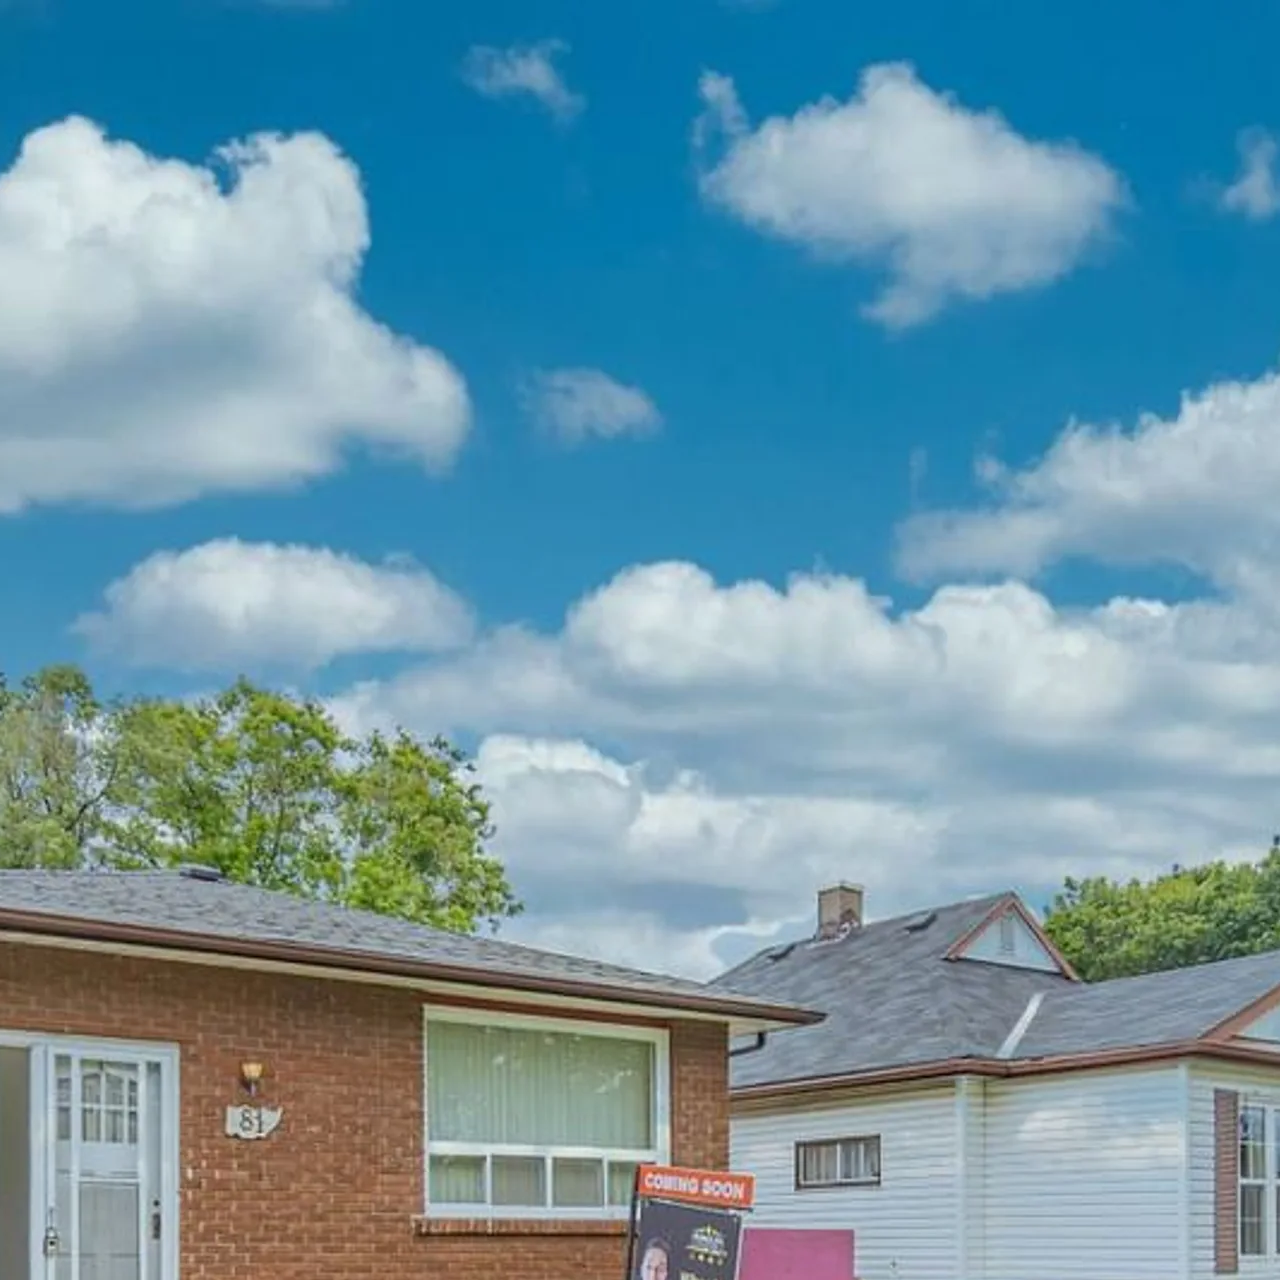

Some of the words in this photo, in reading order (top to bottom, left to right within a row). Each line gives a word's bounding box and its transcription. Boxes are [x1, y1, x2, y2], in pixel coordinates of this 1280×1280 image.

[239, 1108, 263, 1134] 81
[645, 1172, 699, 1195] COMING
[702, 1179, 745, 1200] SOON
